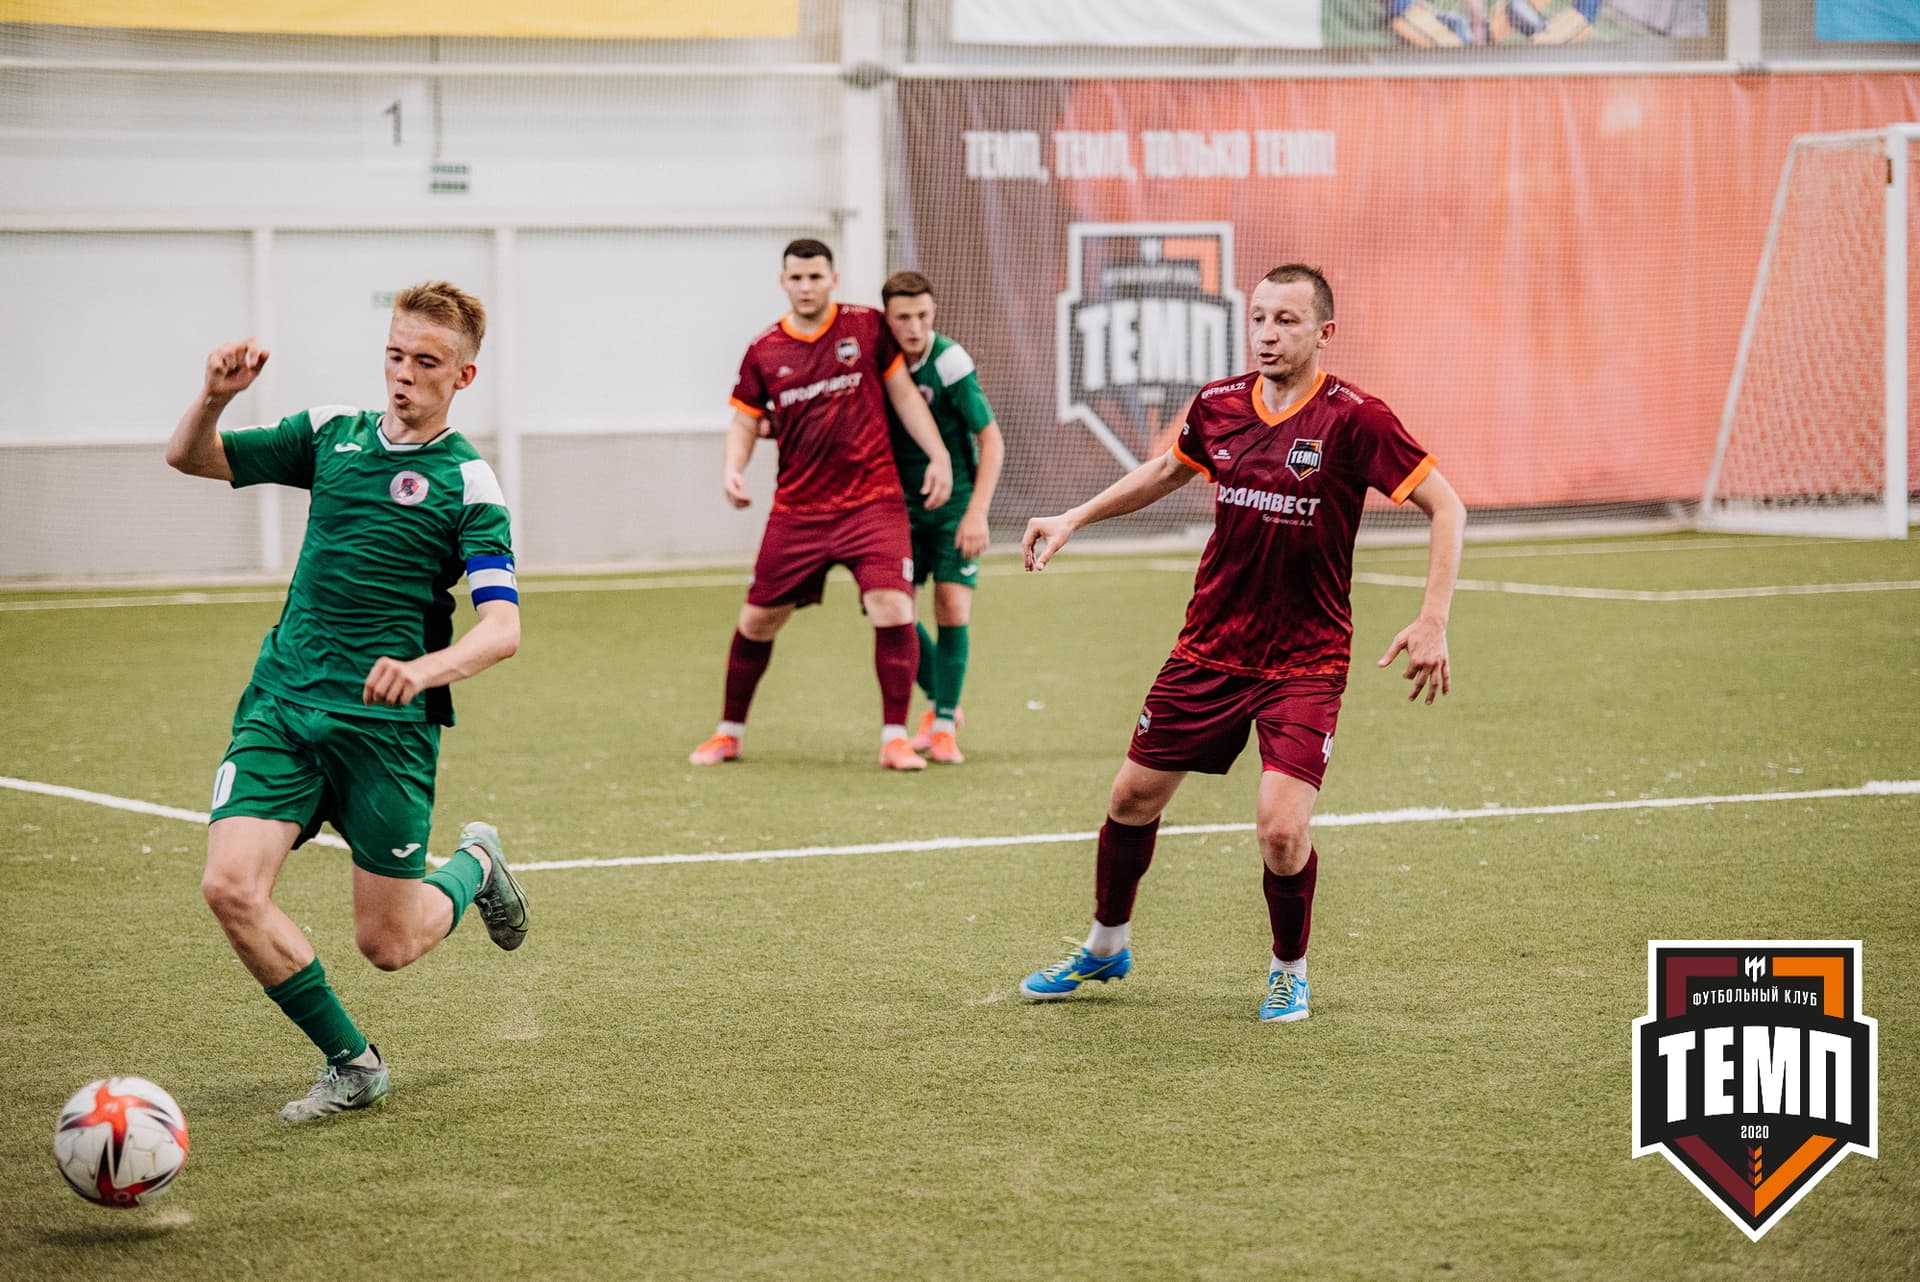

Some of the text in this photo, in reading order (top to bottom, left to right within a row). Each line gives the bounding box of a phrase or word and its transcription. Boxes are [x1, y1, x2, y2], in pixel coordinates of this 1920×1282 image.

[384, 99, 402, 146] 1
[1142, 130, 1250, 178] ТОЛЬКО
[1077, 297, 1229, 391] ТЕМП
[1290, 450, 1319, 467] ТЕМП
